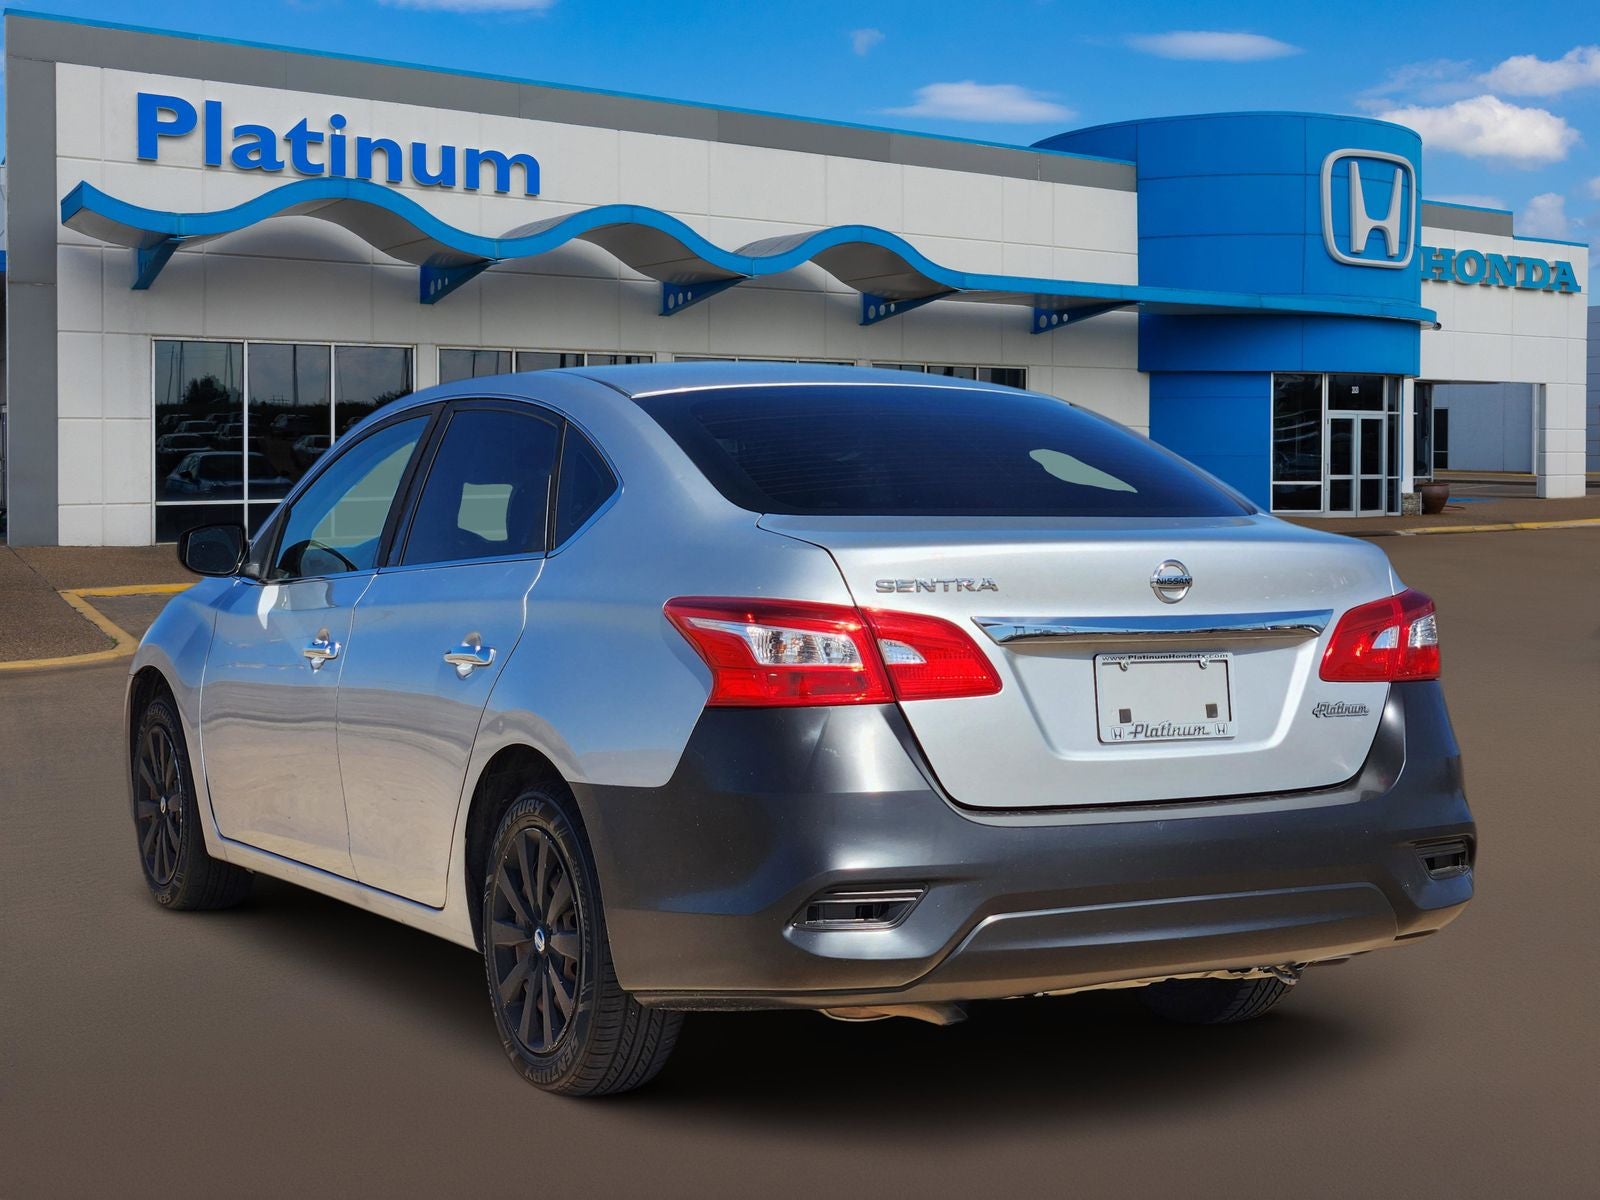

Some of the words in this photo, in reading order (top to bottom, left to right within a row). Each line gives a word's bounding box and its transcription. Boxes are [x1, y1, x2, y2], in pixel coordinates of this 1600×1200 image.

[137, 92, 540, 196] Platinum
[1421, 246, 1581, 293] HONDA
[875, 578, 999, 593] SENTRA
[1156, 577, 1192, 585] NISSAN
[1312, 701, 1369, 718] Platinum
[1128, 720, 1211, 738] Platinum
